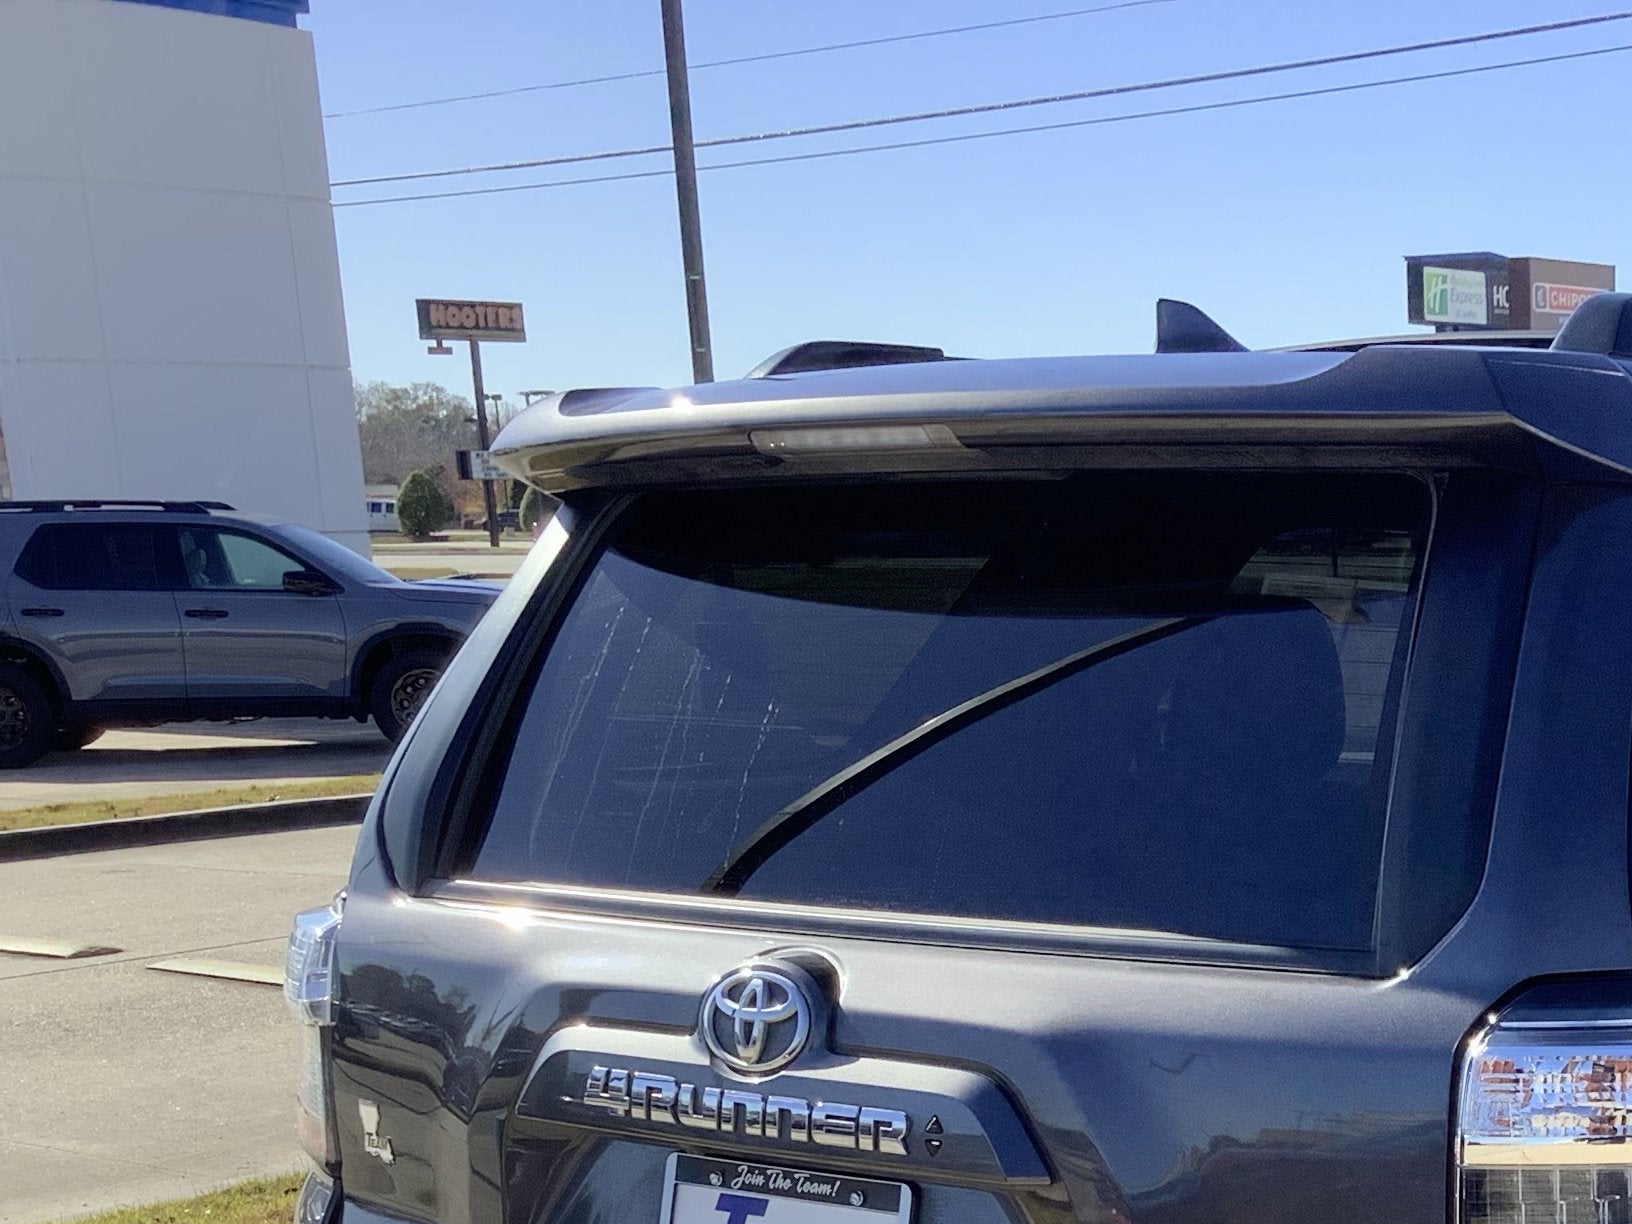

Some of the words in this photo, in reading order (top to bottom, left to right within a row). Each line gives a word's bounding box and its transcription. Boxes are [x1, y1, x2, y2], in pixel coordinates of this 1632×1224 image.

[1493, 285, 1510, 309] HC
[1551, 290, 1591, 306] CHIPO
[429, 303, 522, 331] HOOTERS
[584, 1066, 910, 1156] 4RUNNER
[731, 1165, 765, 1189] Join
[766, 1169, 793, 1190] The
[794, 1173, 840, 1197] Team!
